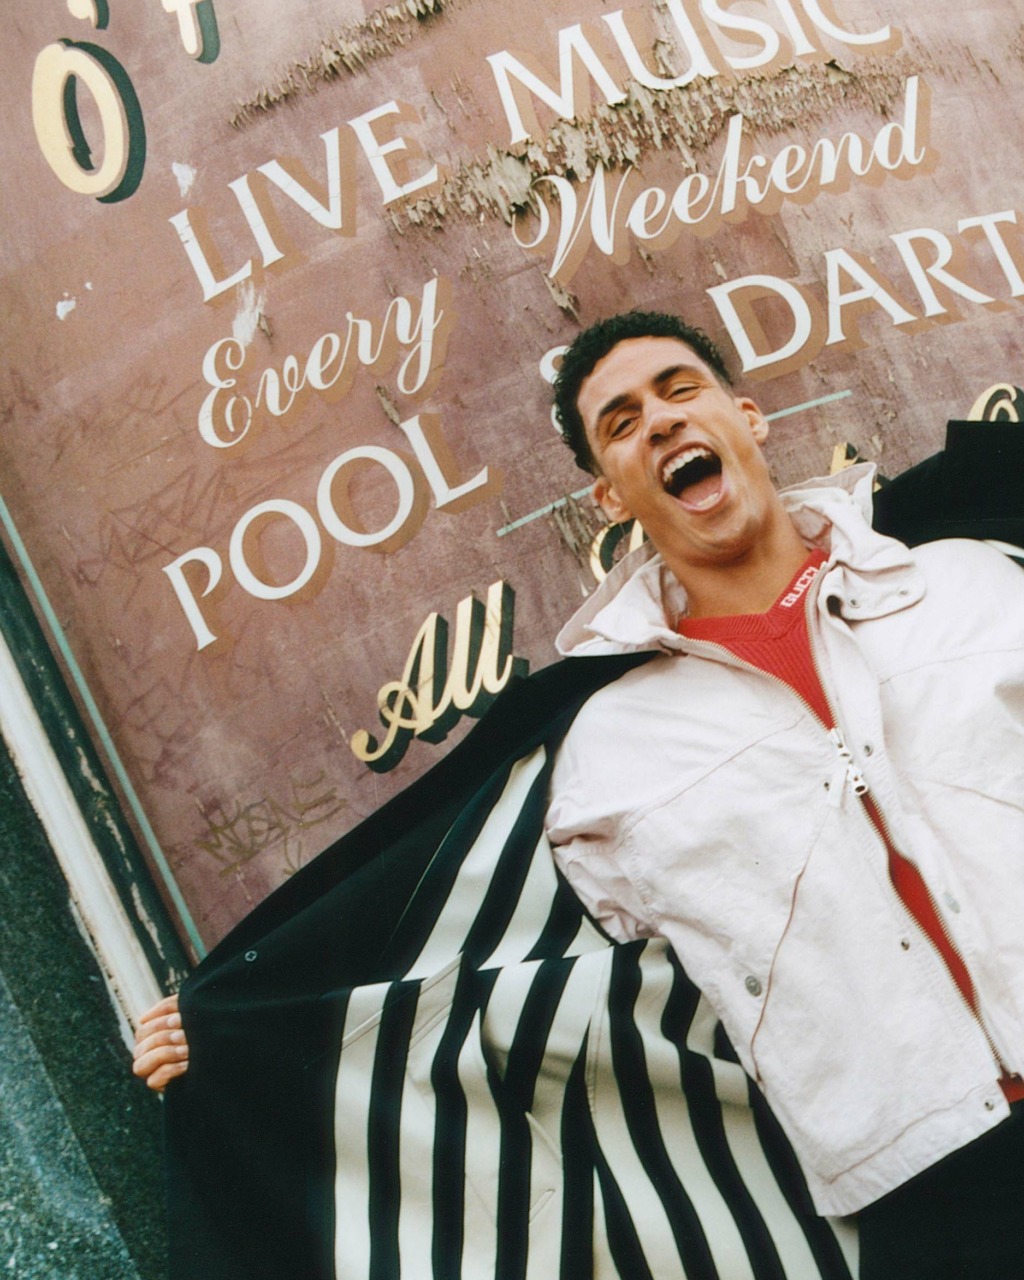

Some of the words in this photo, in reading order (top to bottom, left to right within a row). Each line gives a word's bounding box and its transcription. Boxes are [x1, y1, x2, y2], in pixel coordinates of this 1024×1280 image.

[168, 100, 438, 302] LIVE
[198, 276, 442, 449] Every
[511, 75, 926, 279] Weekend
[161, 412, 489, 651] POOL
[350, 579, 514, 763] All
